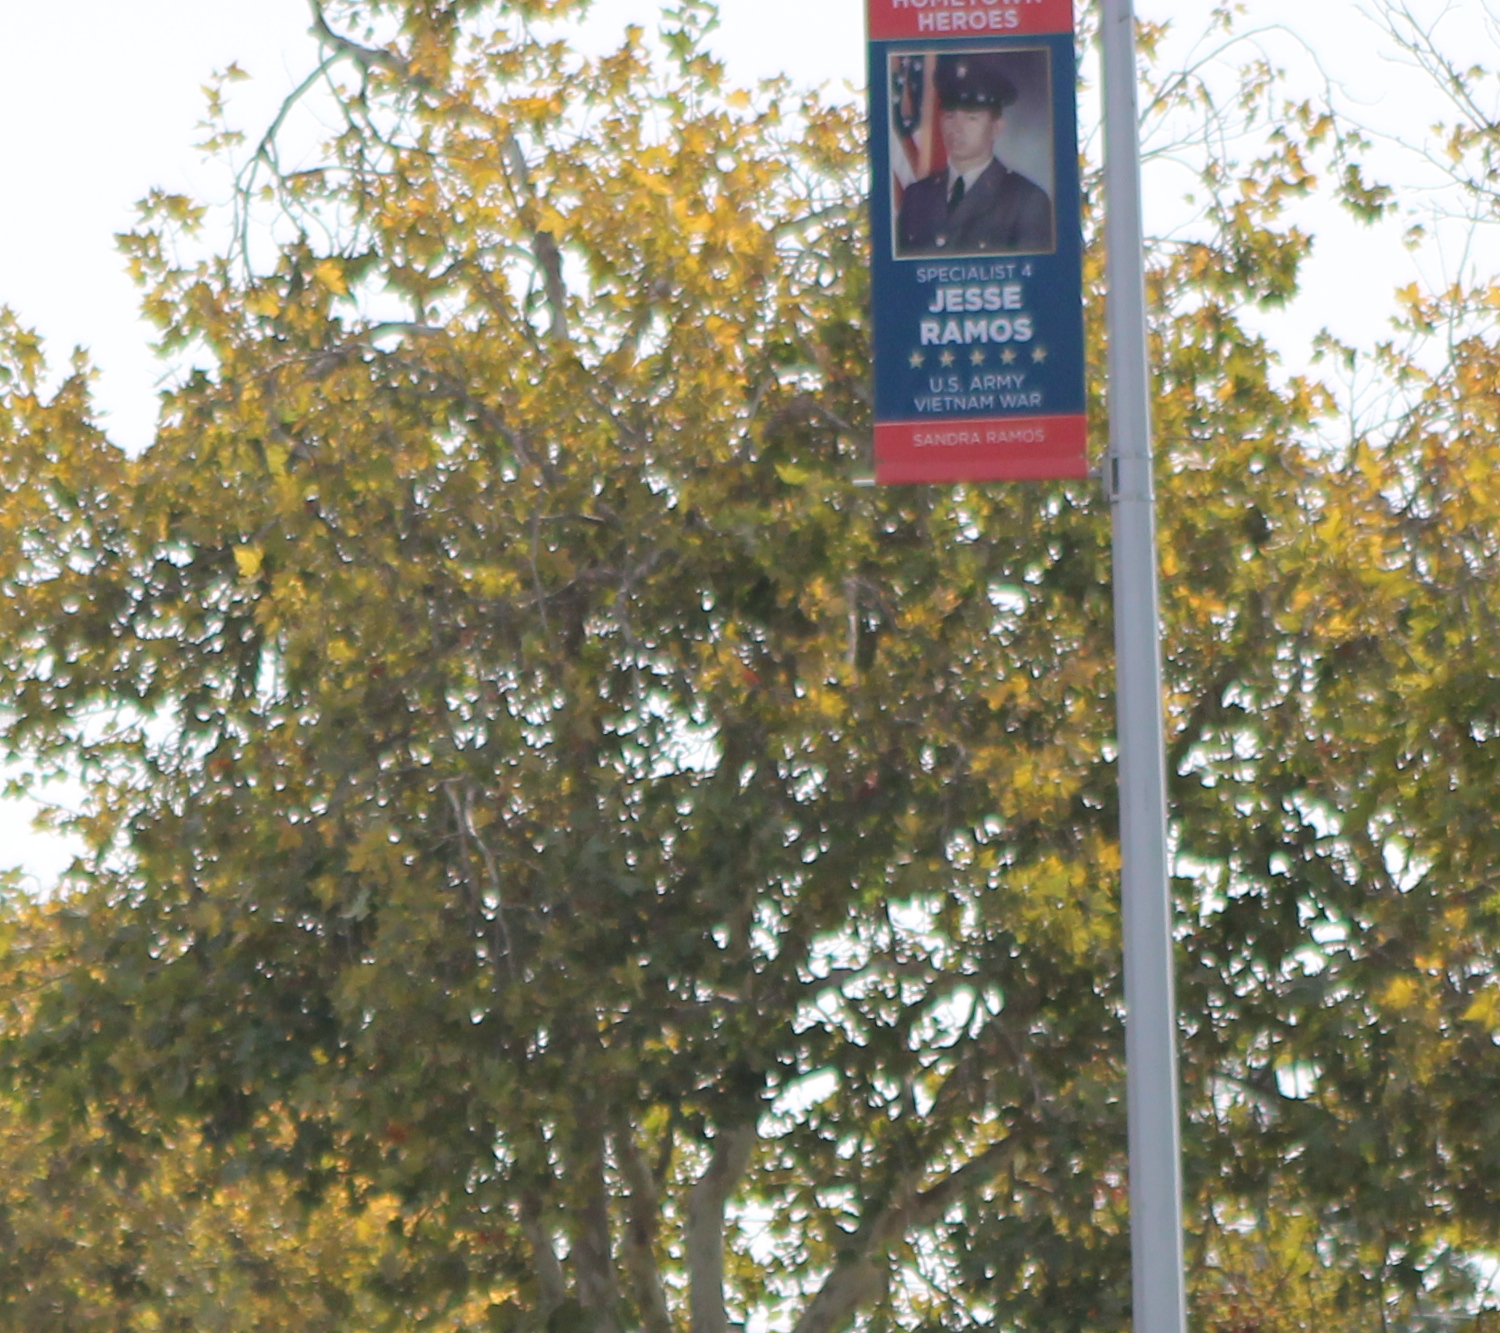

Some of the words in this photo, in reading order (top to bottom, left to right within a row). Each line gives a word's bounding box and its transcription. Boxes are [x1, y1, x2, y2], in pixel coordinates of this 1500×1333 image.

[918, 9, 1019, 31] HEROES
[916, 264, 1016, 283] SPECIALIST
[1021, 264, 1032, 278] 4
[928, 285, 1022, 313] JESSE
[920, 317, 1033, 345] RAMOS
[929, 376, 963, 393] U.S.
[969, 374, 1025, 391] ARMY
[914, 394, 994, 412] VIETNAM
[999, 392, 1042, 409] WAR
[913, 431, 981, 447] SANDRA
[986, 429, 1045, 444] RAMOS
